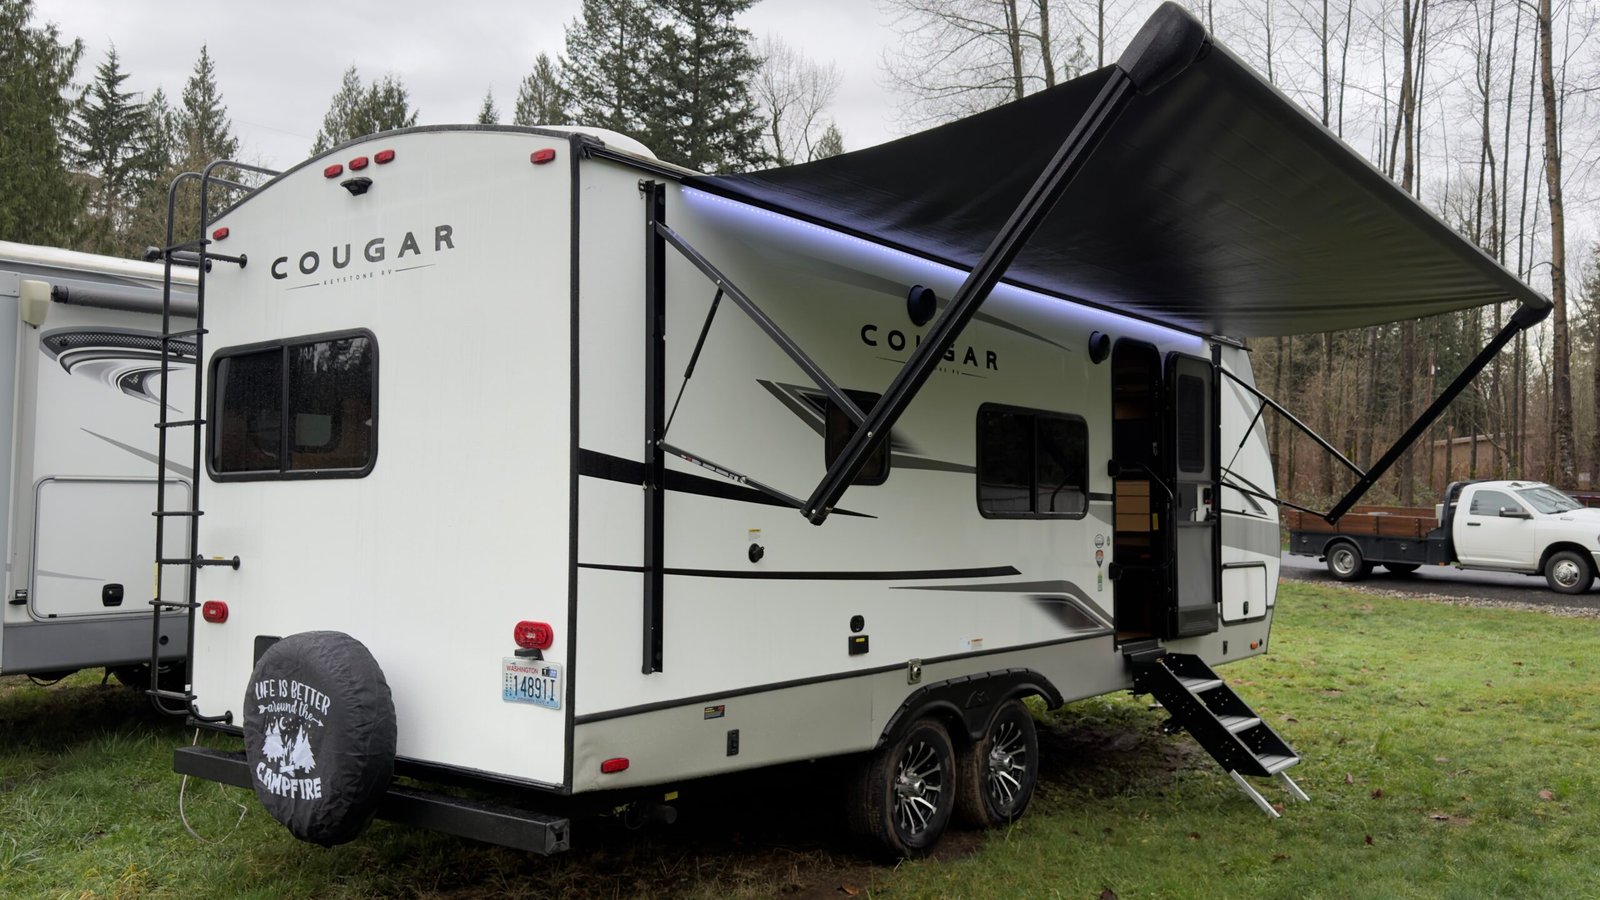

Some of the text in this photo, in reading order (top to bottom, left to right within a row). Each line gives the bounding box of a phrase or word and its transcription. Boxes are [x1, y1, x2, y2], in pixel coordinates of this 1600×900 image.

[271, 224, 455, 280] COUGAR
[323, 271, 374, 286] KEYSTONE
[860, 324, 998, 371] COGAR
[505, 664, 539, 674] WASHINGTON
[255, 679, 331, 716] LIFE IS BETTER
[267, 700, 314, 721] around the
[256, 761, 322, 800] CAMPFIRE
